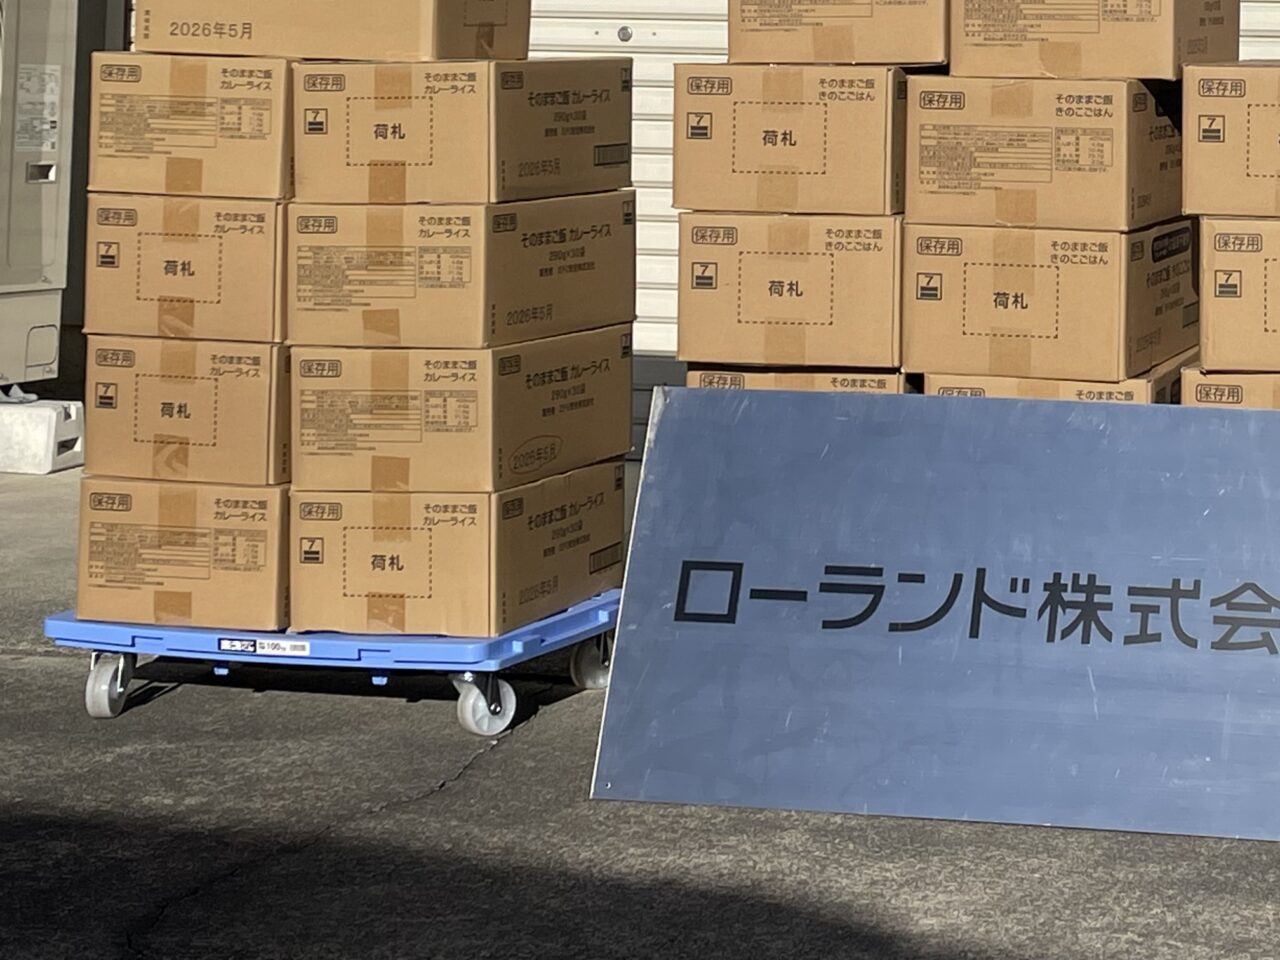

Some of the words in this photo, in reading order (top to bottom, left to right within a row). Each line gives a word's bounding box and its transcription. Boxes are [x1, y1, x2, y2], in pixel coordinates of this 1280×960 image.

[170, 22, 252, 40] 2026年5月
[306, 76, 344, 90] 保存用
[424, 72, 477, 83] そのままご飯
[818, 78, 876, 90] そのままご飯
[424, 84, 477, 95] カレーライス
[689, 78, 731, 94] 保存用
[1200, 80, 1244, 96] 保存用
[818, 90, 876, 102] きのこごはん
[922, 93, 964, 108] 保存用
[1054, 94, 1114, 106] そのままご飯
[1054, 106, 1114, 118] きのこごはん
[374, 122, 406, 140] 荷札
[762, 129, 798, 148] 荷札
[214, 212, 266, 224] そのままご飯
[299, 217, 336, 232] 保存用
[418, 216, 472, 227] そのままご飯
[213, 224, 266, 235] カレーライス
[418, 228, 472, 239] カレーライス
[694, 228, 736, 244] 保存用
[824, 228, 883, 240] そのままご飯
[824, 241, 883, 252] きのこごはん
[918, 239, 961, 254] 保存用
[1050, 240, 1108, 253] そのままご飯
[1216, 234, 1260, 250] 保存用
[1050, 254, 1108, 266] きのこごはん
[164, 260, 196, 277] 荷札
[768, 280, 804, 298] 荷札
[992, 291, 1029, 310] 荷札
[302, 361, 340, 376] 保存用
[424, 360, 477, 370] そのままご飯
[423, 372, 477, 383] カレーライス
[830, 376, 887, 390] そのままご飯
[1075, 390, 1134, 402] そのままご飯
[1198, 386, 1240, 402] 保存用
[160, 402, 192, 420] 荷札
[301, 504, 340, 520] 保存用
[424, 503, 478, 515] そのままご飯
[422, 516, 478, 527] カレーライス
[371, 554, 405, 572] 荷札
